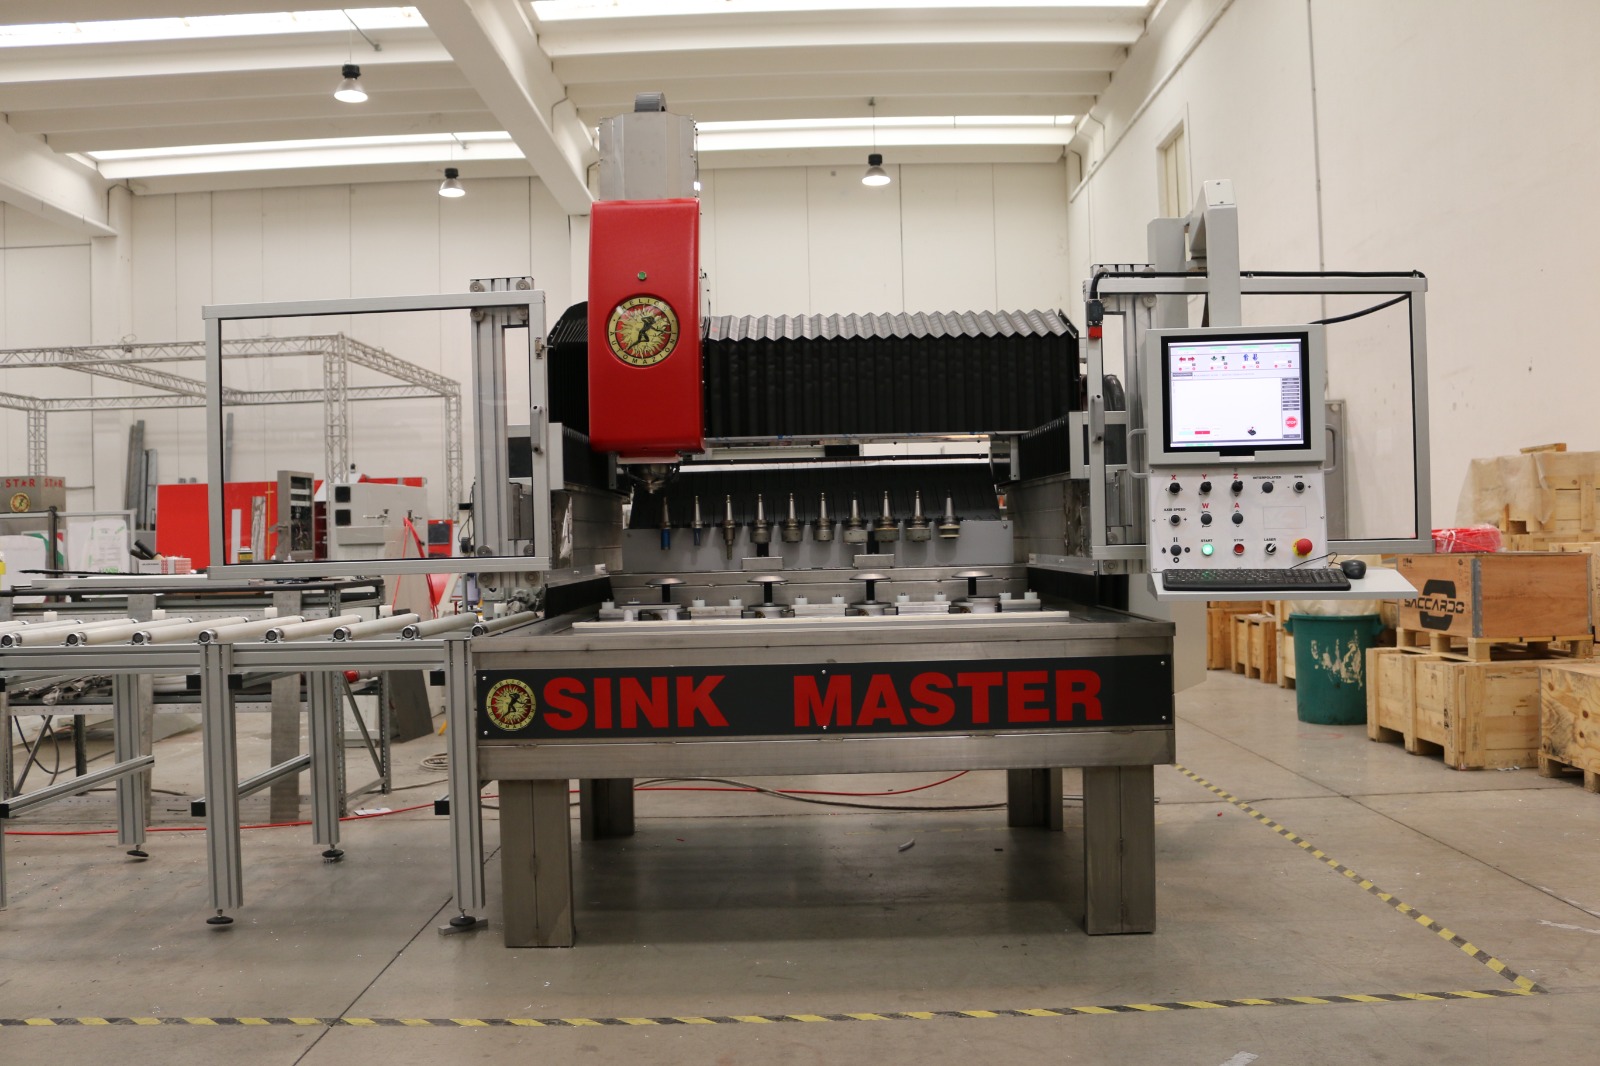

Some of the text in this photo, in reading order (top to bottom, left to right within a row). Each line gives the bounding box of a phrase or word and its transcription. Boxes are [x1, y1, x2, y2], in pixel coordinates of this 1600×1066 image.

[621, 298, 668, 312] HELIOS
[609, 331, 677, 365] AUTOMAZIONI
[1404, 598, 1464, 613] SACCARDO
[543, 669, 1103, 731] SINK MASTER
